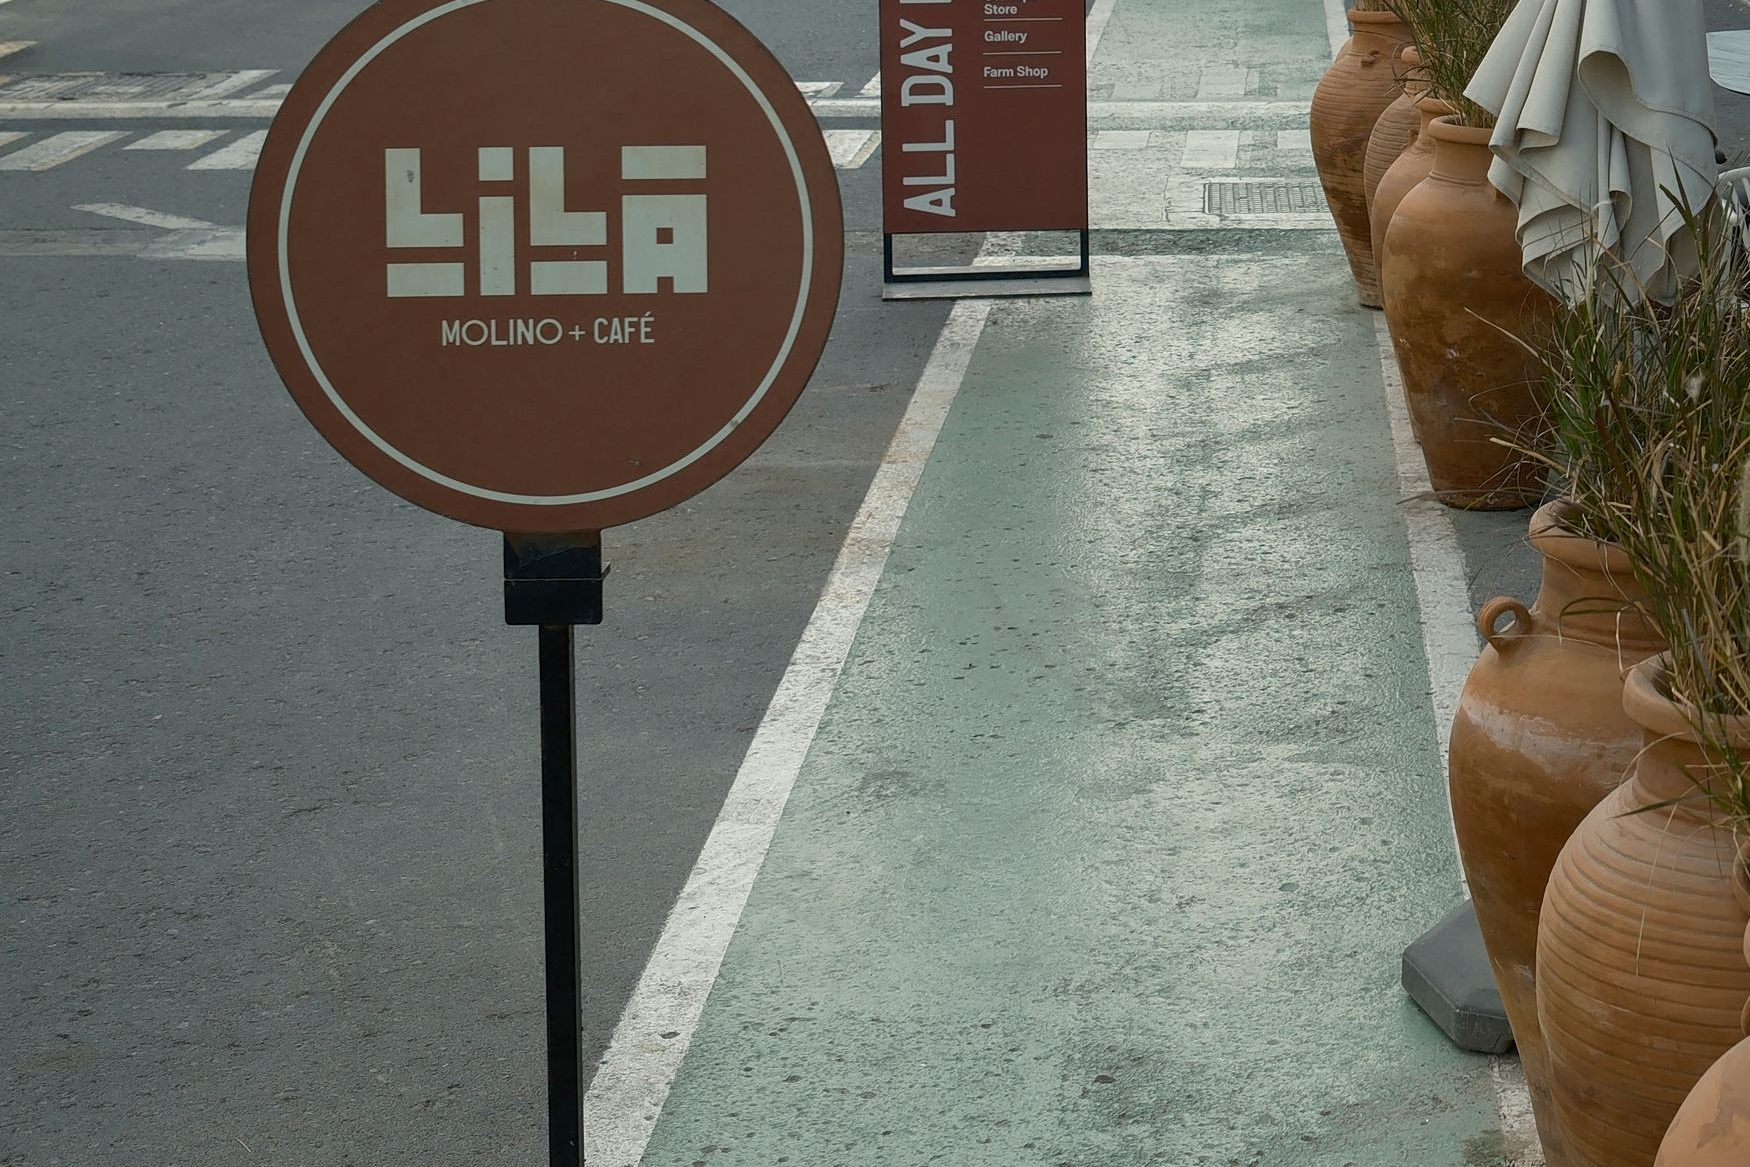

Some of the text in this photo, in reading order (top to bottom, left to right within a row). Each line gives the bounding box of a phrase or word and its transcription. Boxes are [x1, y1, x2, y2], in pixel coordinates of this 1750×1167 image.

[984, 3, 1018, 15] Store
[984, 30, 1028, 44] Gallery
[899, 19, 954, 107] DAY
[984, 66, 1049, 79] Farm Shop
[902, 120, 956, 217] ALL
[441, 311, 655, 347] MOLINO + CAFÉ
